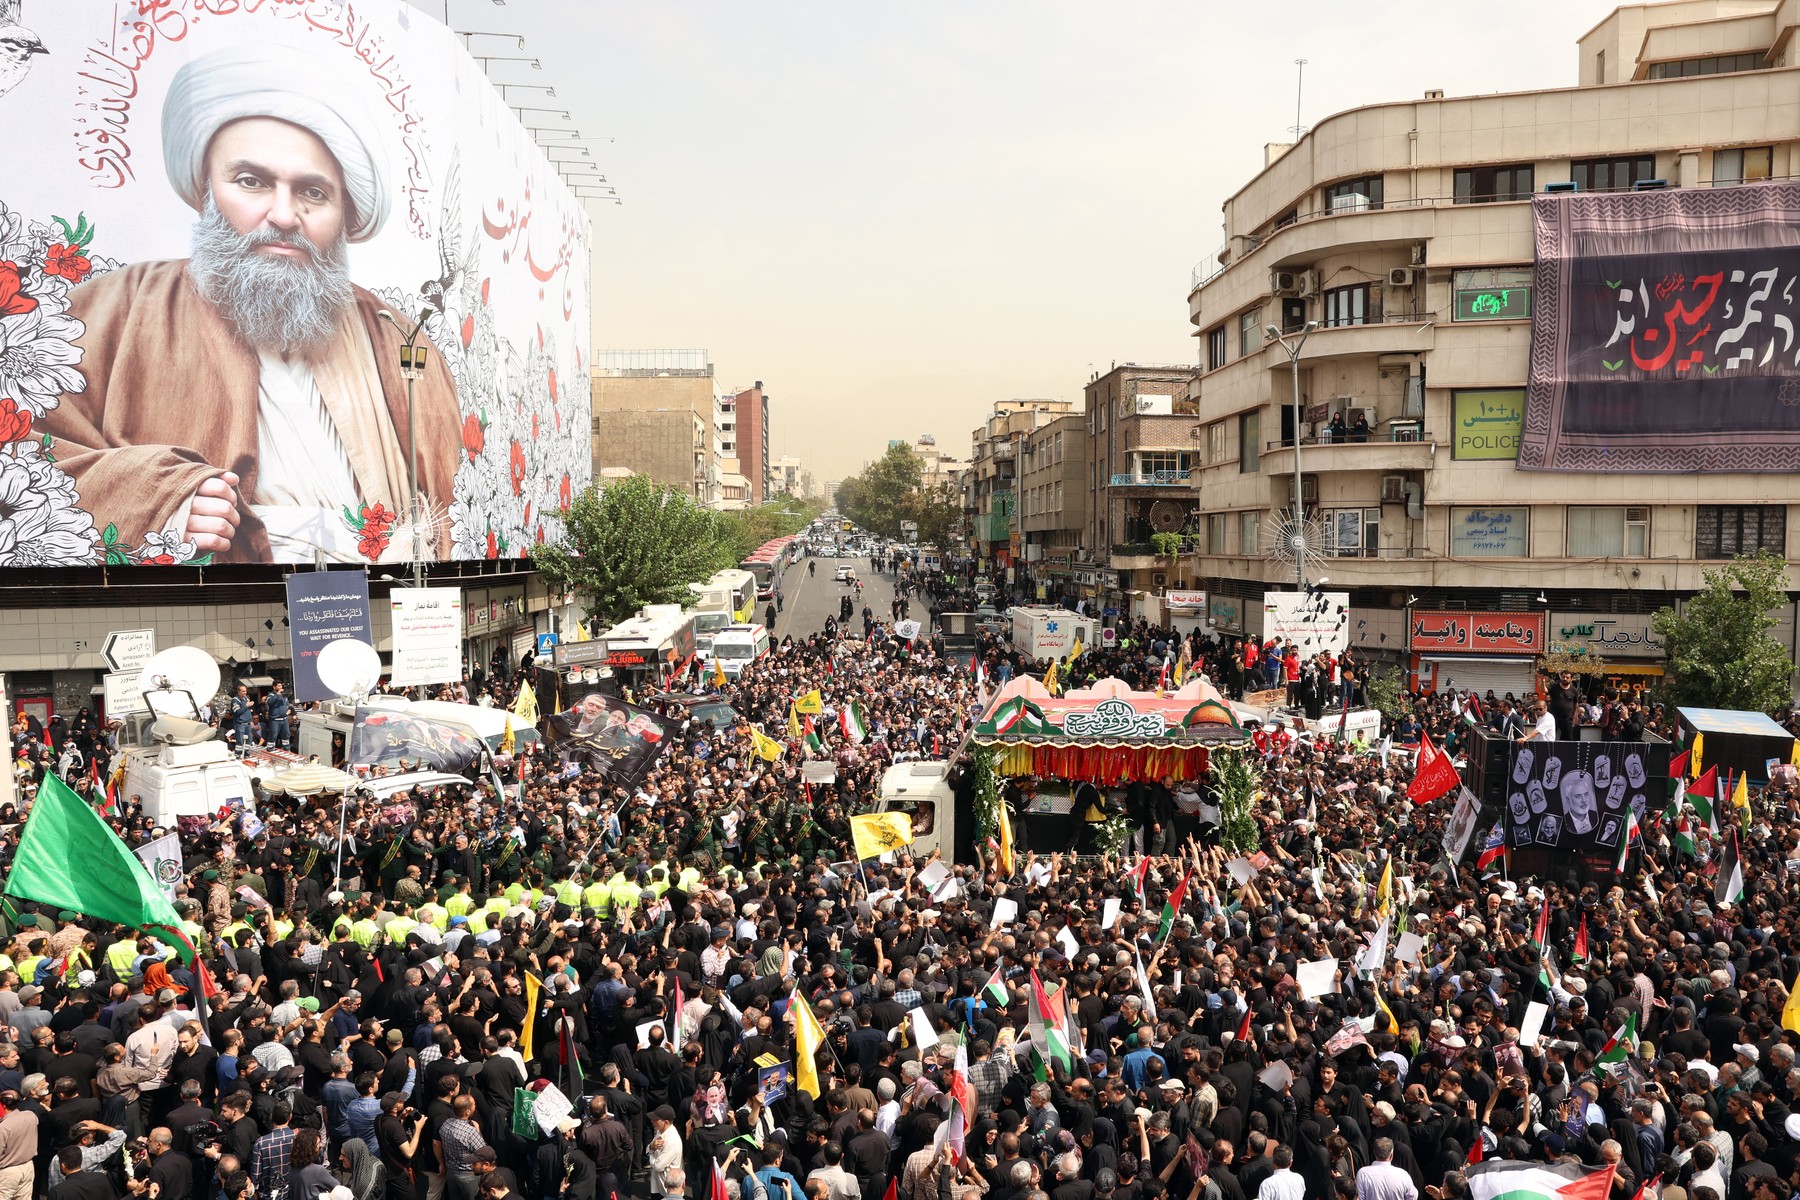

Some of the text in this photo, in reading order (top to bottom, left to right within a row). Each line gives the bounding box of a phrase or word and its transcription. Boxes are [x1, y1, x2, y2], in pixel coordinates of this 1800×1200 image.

[1630, 271, 1725, 372] حسین
[1463, 407, 1521, 428] پلیس
[1461, 435, 1521, 449] POLICE
[309, 627, 340, 635] ASSASSINATED
[1414, 619, 1534, 644] ویتامینه وانیلا
[1561, 625, 1595, 640] کلاب
